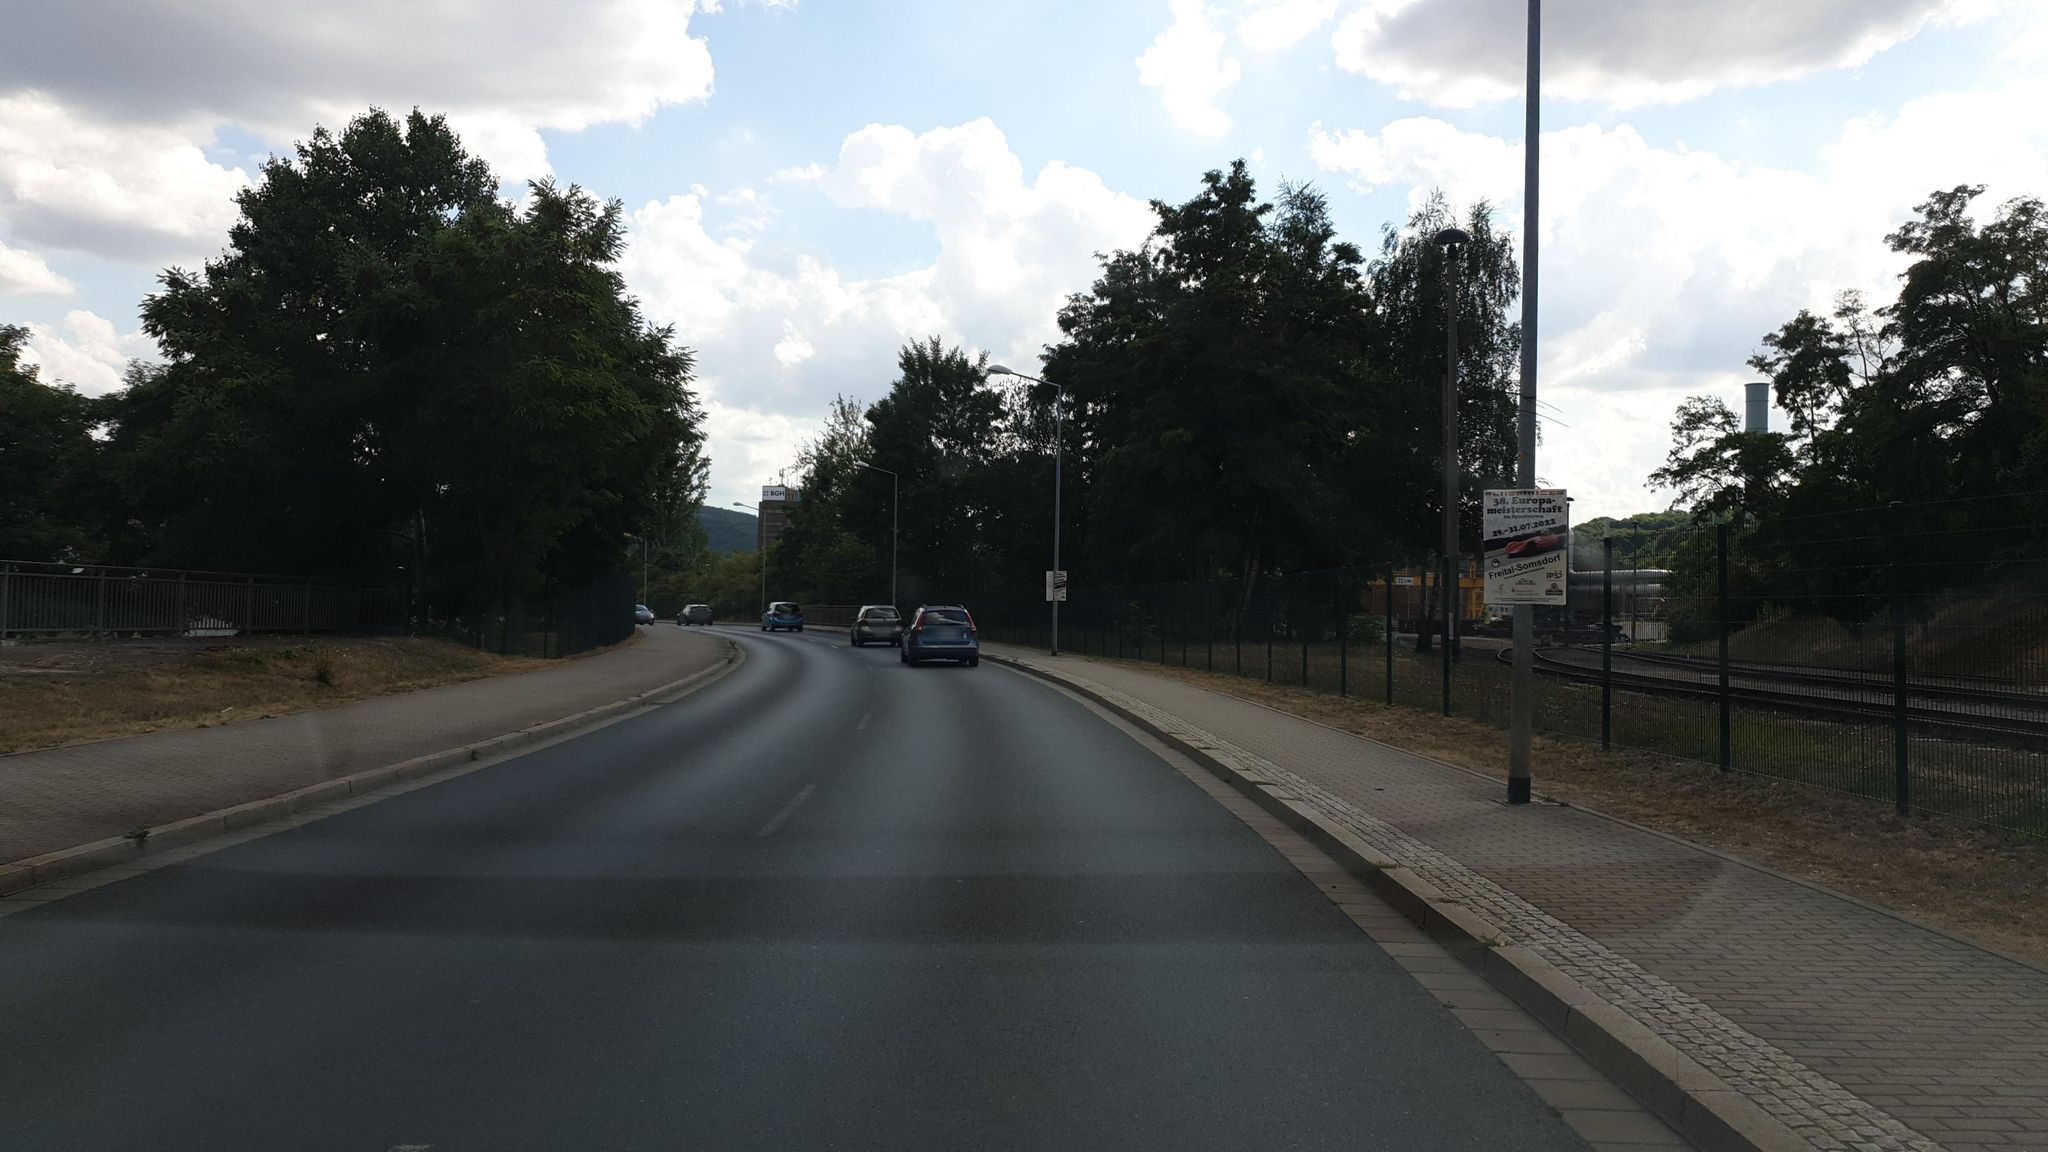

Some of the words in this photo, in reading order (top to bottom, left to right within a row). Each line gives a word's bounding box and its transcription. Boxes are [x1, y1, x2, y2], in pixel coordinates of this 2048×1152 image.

[1493, 497, 1509, 506] 38.
[1512, 497, 1556, 506] Europa-
[1487, 505, 1563, 514] meisterschaft
[1488, 554, 1561, 579] Freital-Somsdorf
